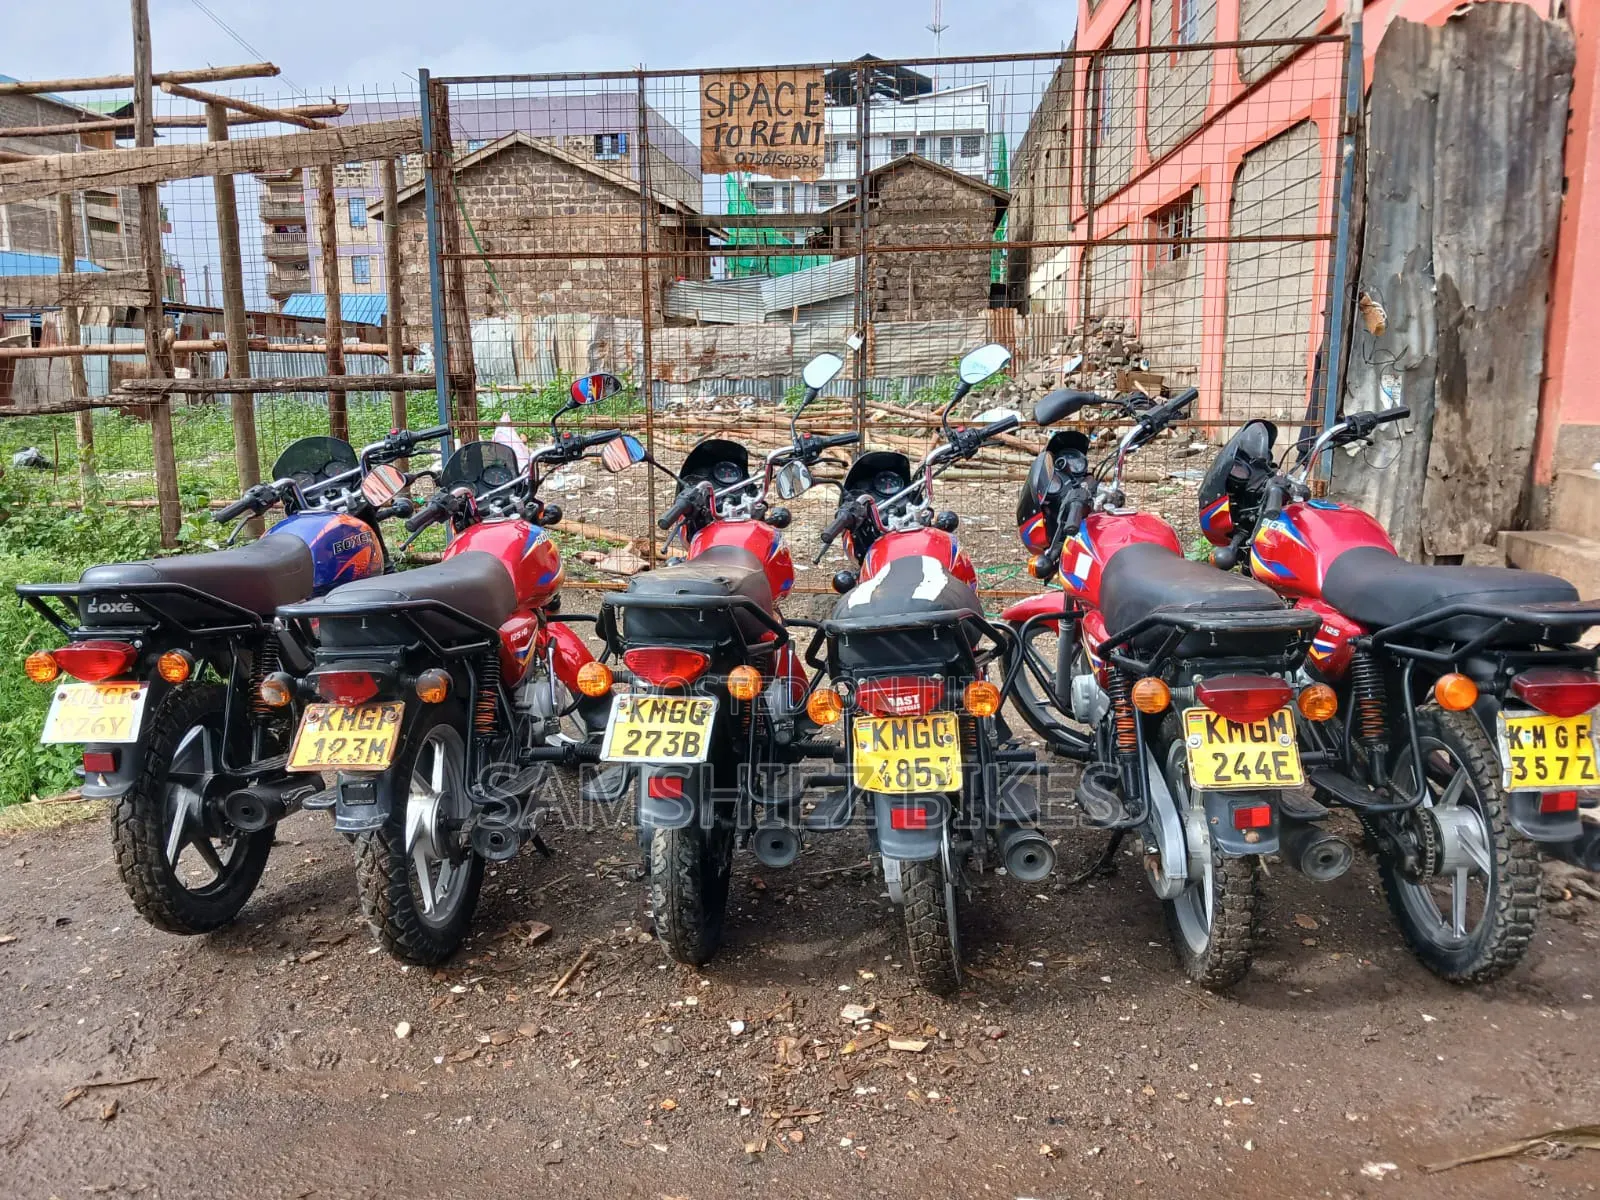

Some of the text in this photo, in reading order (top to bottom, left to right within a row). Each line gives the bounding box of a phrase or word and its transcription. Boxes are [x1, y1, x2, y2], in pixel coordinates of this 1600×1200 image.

[704, 81, 821, 118] SPACE
[705, 119, 824, 152] TO RENT
[1205, 711, 1289, 744] KMGM
[307, 737, 388, 763] 123M
[623, 729, 701, 757] 273B
[1212, 751, 1294, 781] 244E
[1512, 756, 1595, 780] 357Z
